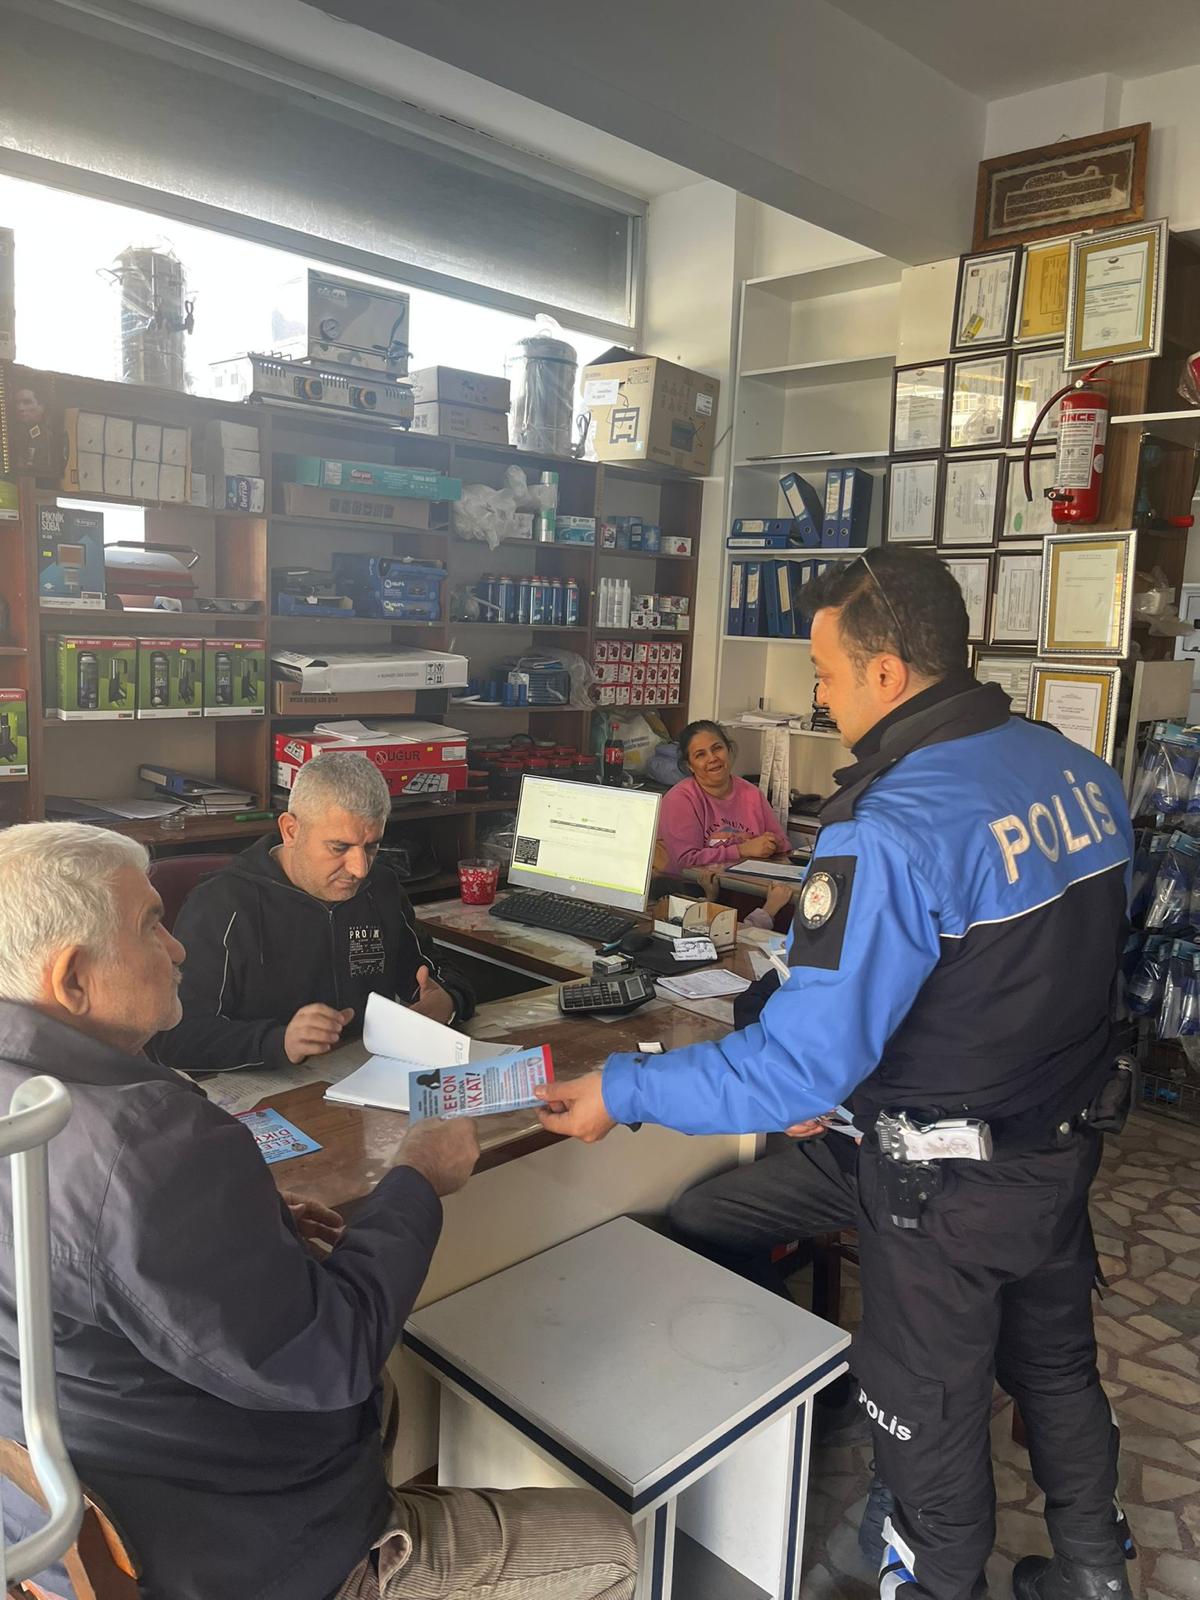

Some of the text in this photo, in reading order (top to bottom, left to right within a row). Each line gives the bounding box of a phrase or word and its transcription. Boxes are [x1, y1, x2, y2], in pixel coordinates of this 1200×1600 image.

[989, 769, 1117, 885] POLİS
[443, 1074, 458, 1112] EFON
[858, 1388, 912, 1441] POLİS
